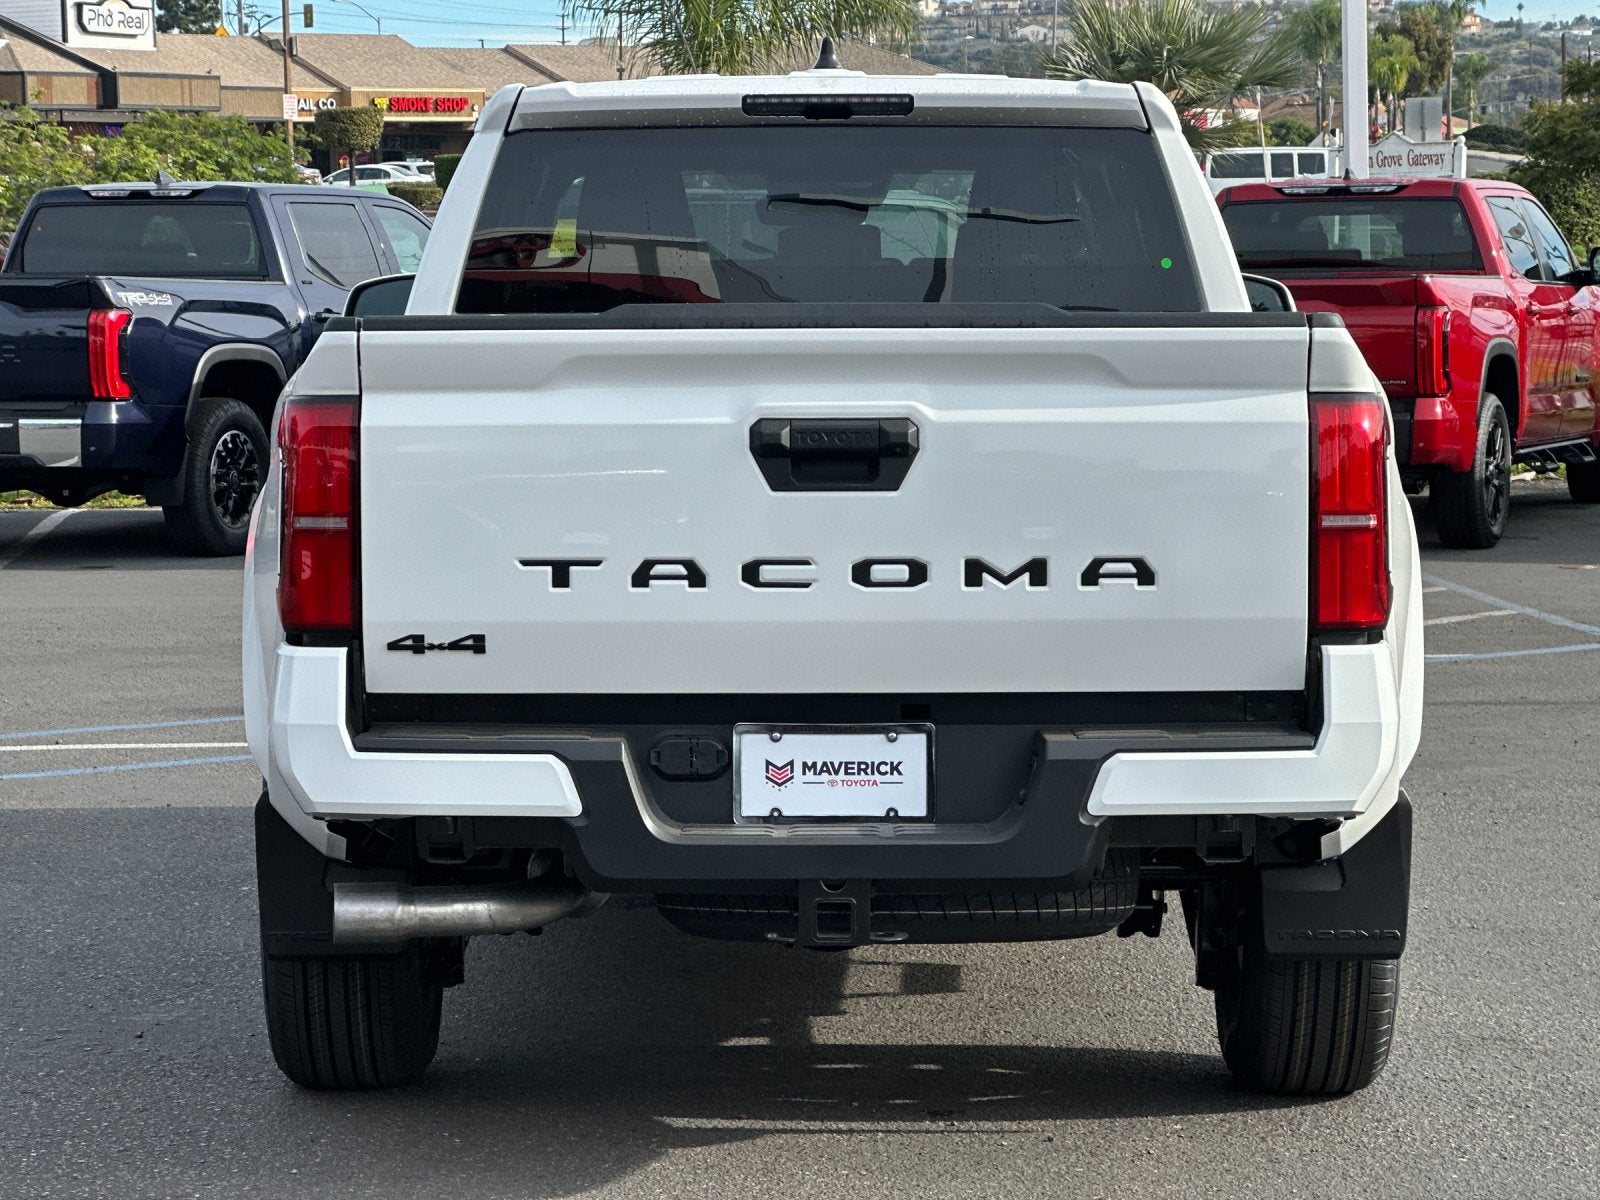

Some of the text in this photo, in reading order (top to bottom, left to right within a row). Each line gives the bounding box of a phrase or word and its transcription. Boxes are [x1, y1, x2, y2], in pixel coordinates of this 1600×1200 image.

[118, 11, 145, 29] Real
[298, 97, 317, 110] AIL
[319, 97, 336, 110] CO
[391, 96, 433, 111] SMOKE
[436, 96, 469, 111] SHOP
[1376, 150, 1403, 168] Grove
[1407, 148, 1446, 170] Gateway
[794, 431, 874, 445] TOYOTA
[514, 556, 1158, 592] TACOMA
[386, 634, 486, 655] 4x4
[801, 760, 904, 776] MAVERICK
[840, 779, 879, 787] TOYOTA
